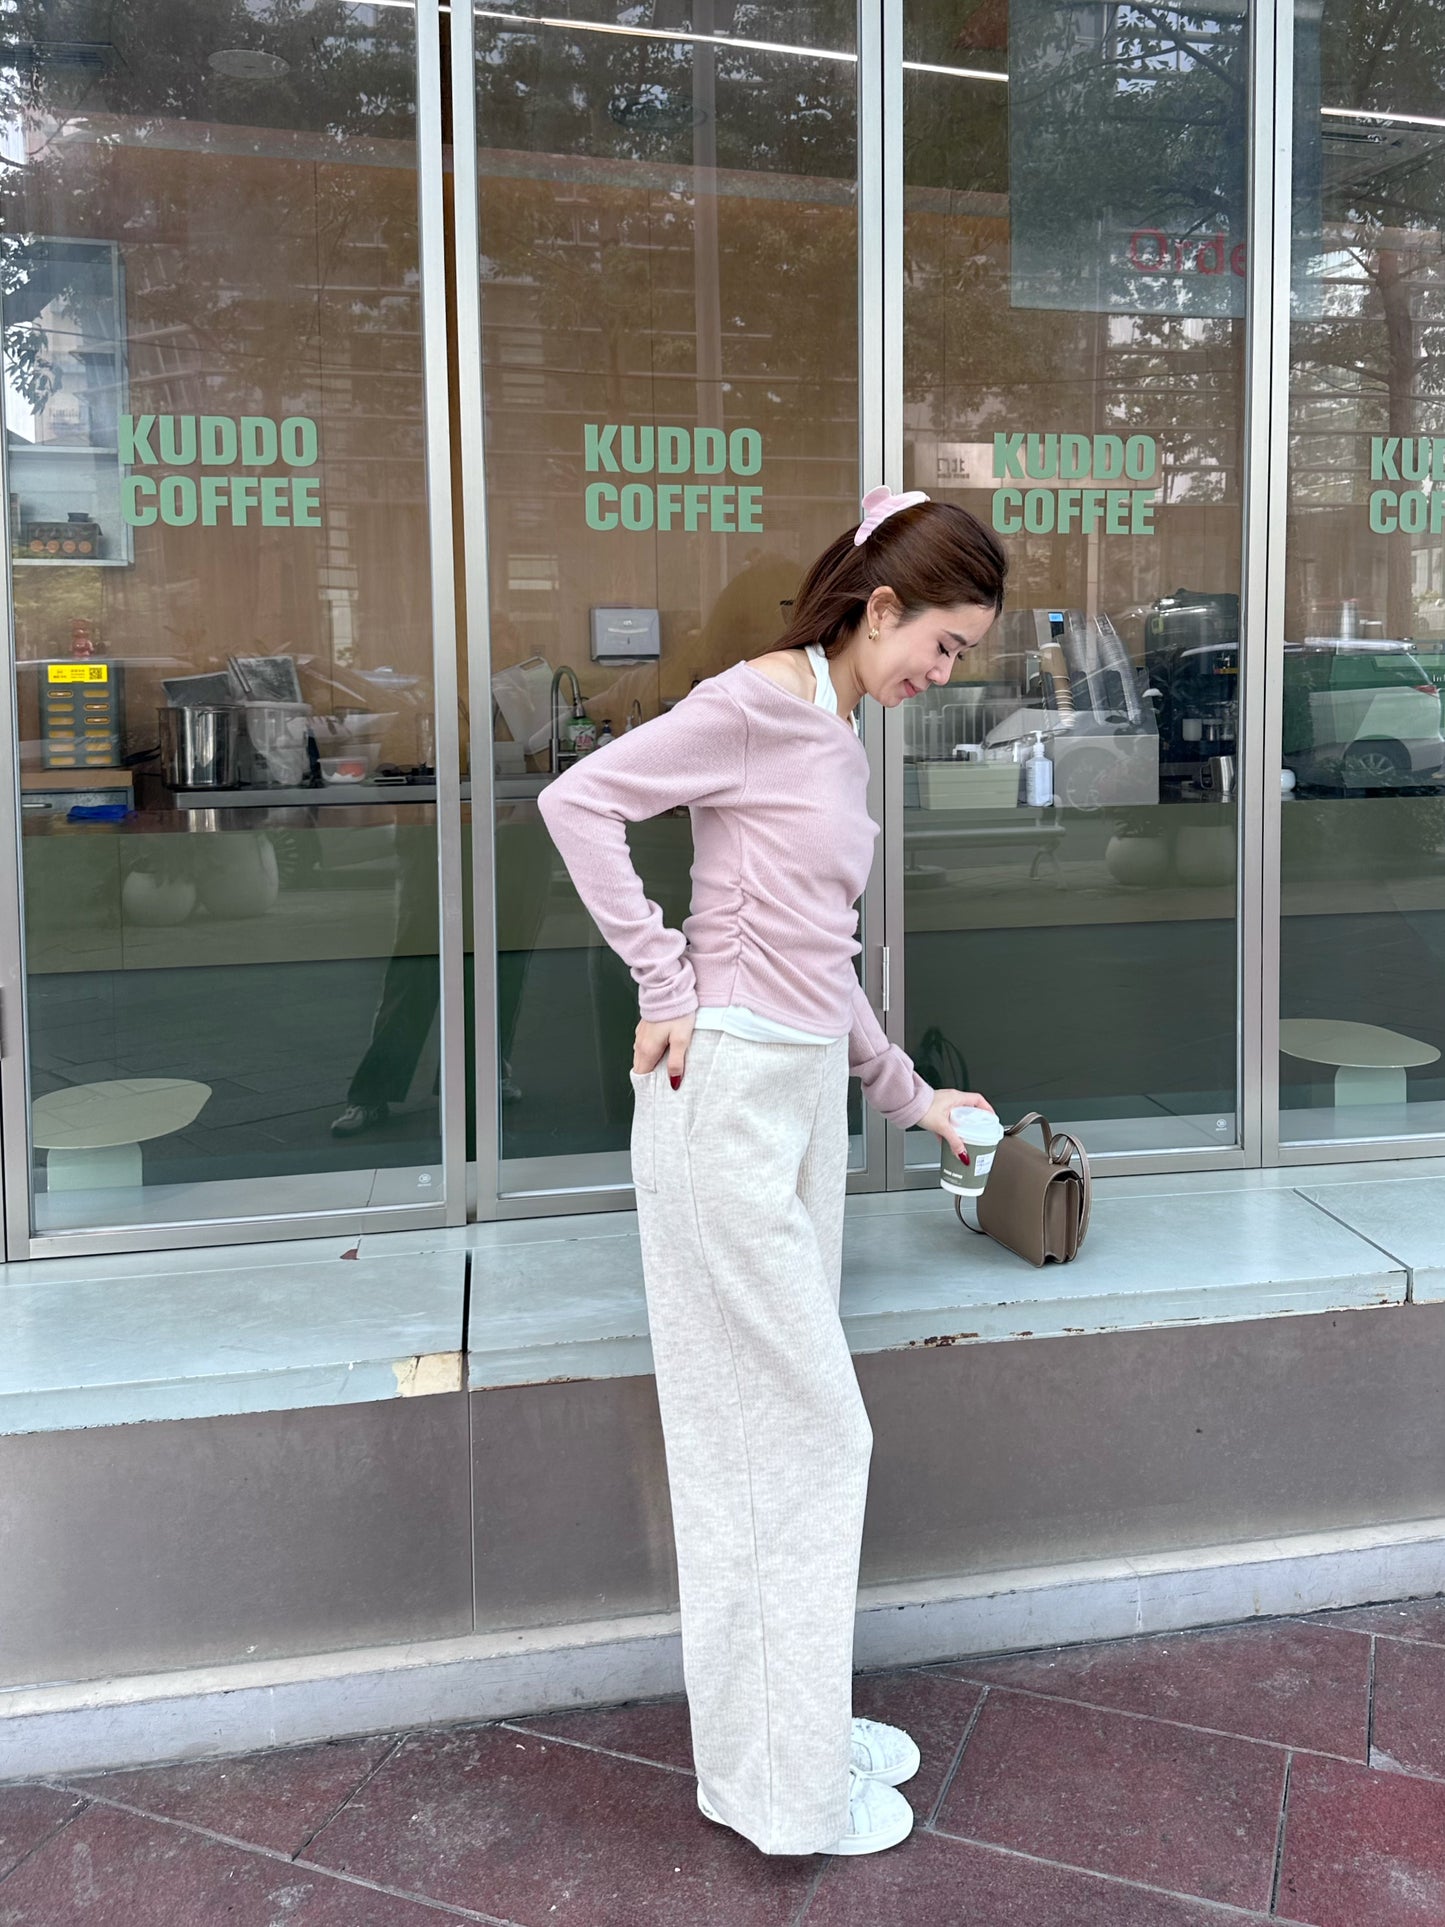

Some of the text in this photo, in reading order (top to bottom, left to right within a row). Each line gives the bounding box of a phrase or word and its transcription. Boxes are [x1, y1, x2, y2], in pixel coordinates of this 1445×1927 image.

[118, 414, 318, 468] KUDDO
[584, 423, 762, 477] KUDDO
[992, 432, 1157, 482] KUDDO
[119, 474, 322, 528] COFFEE
[583, 482, 764, 533] COFFEE
[991, 488, 1156, 536] COFFEE
